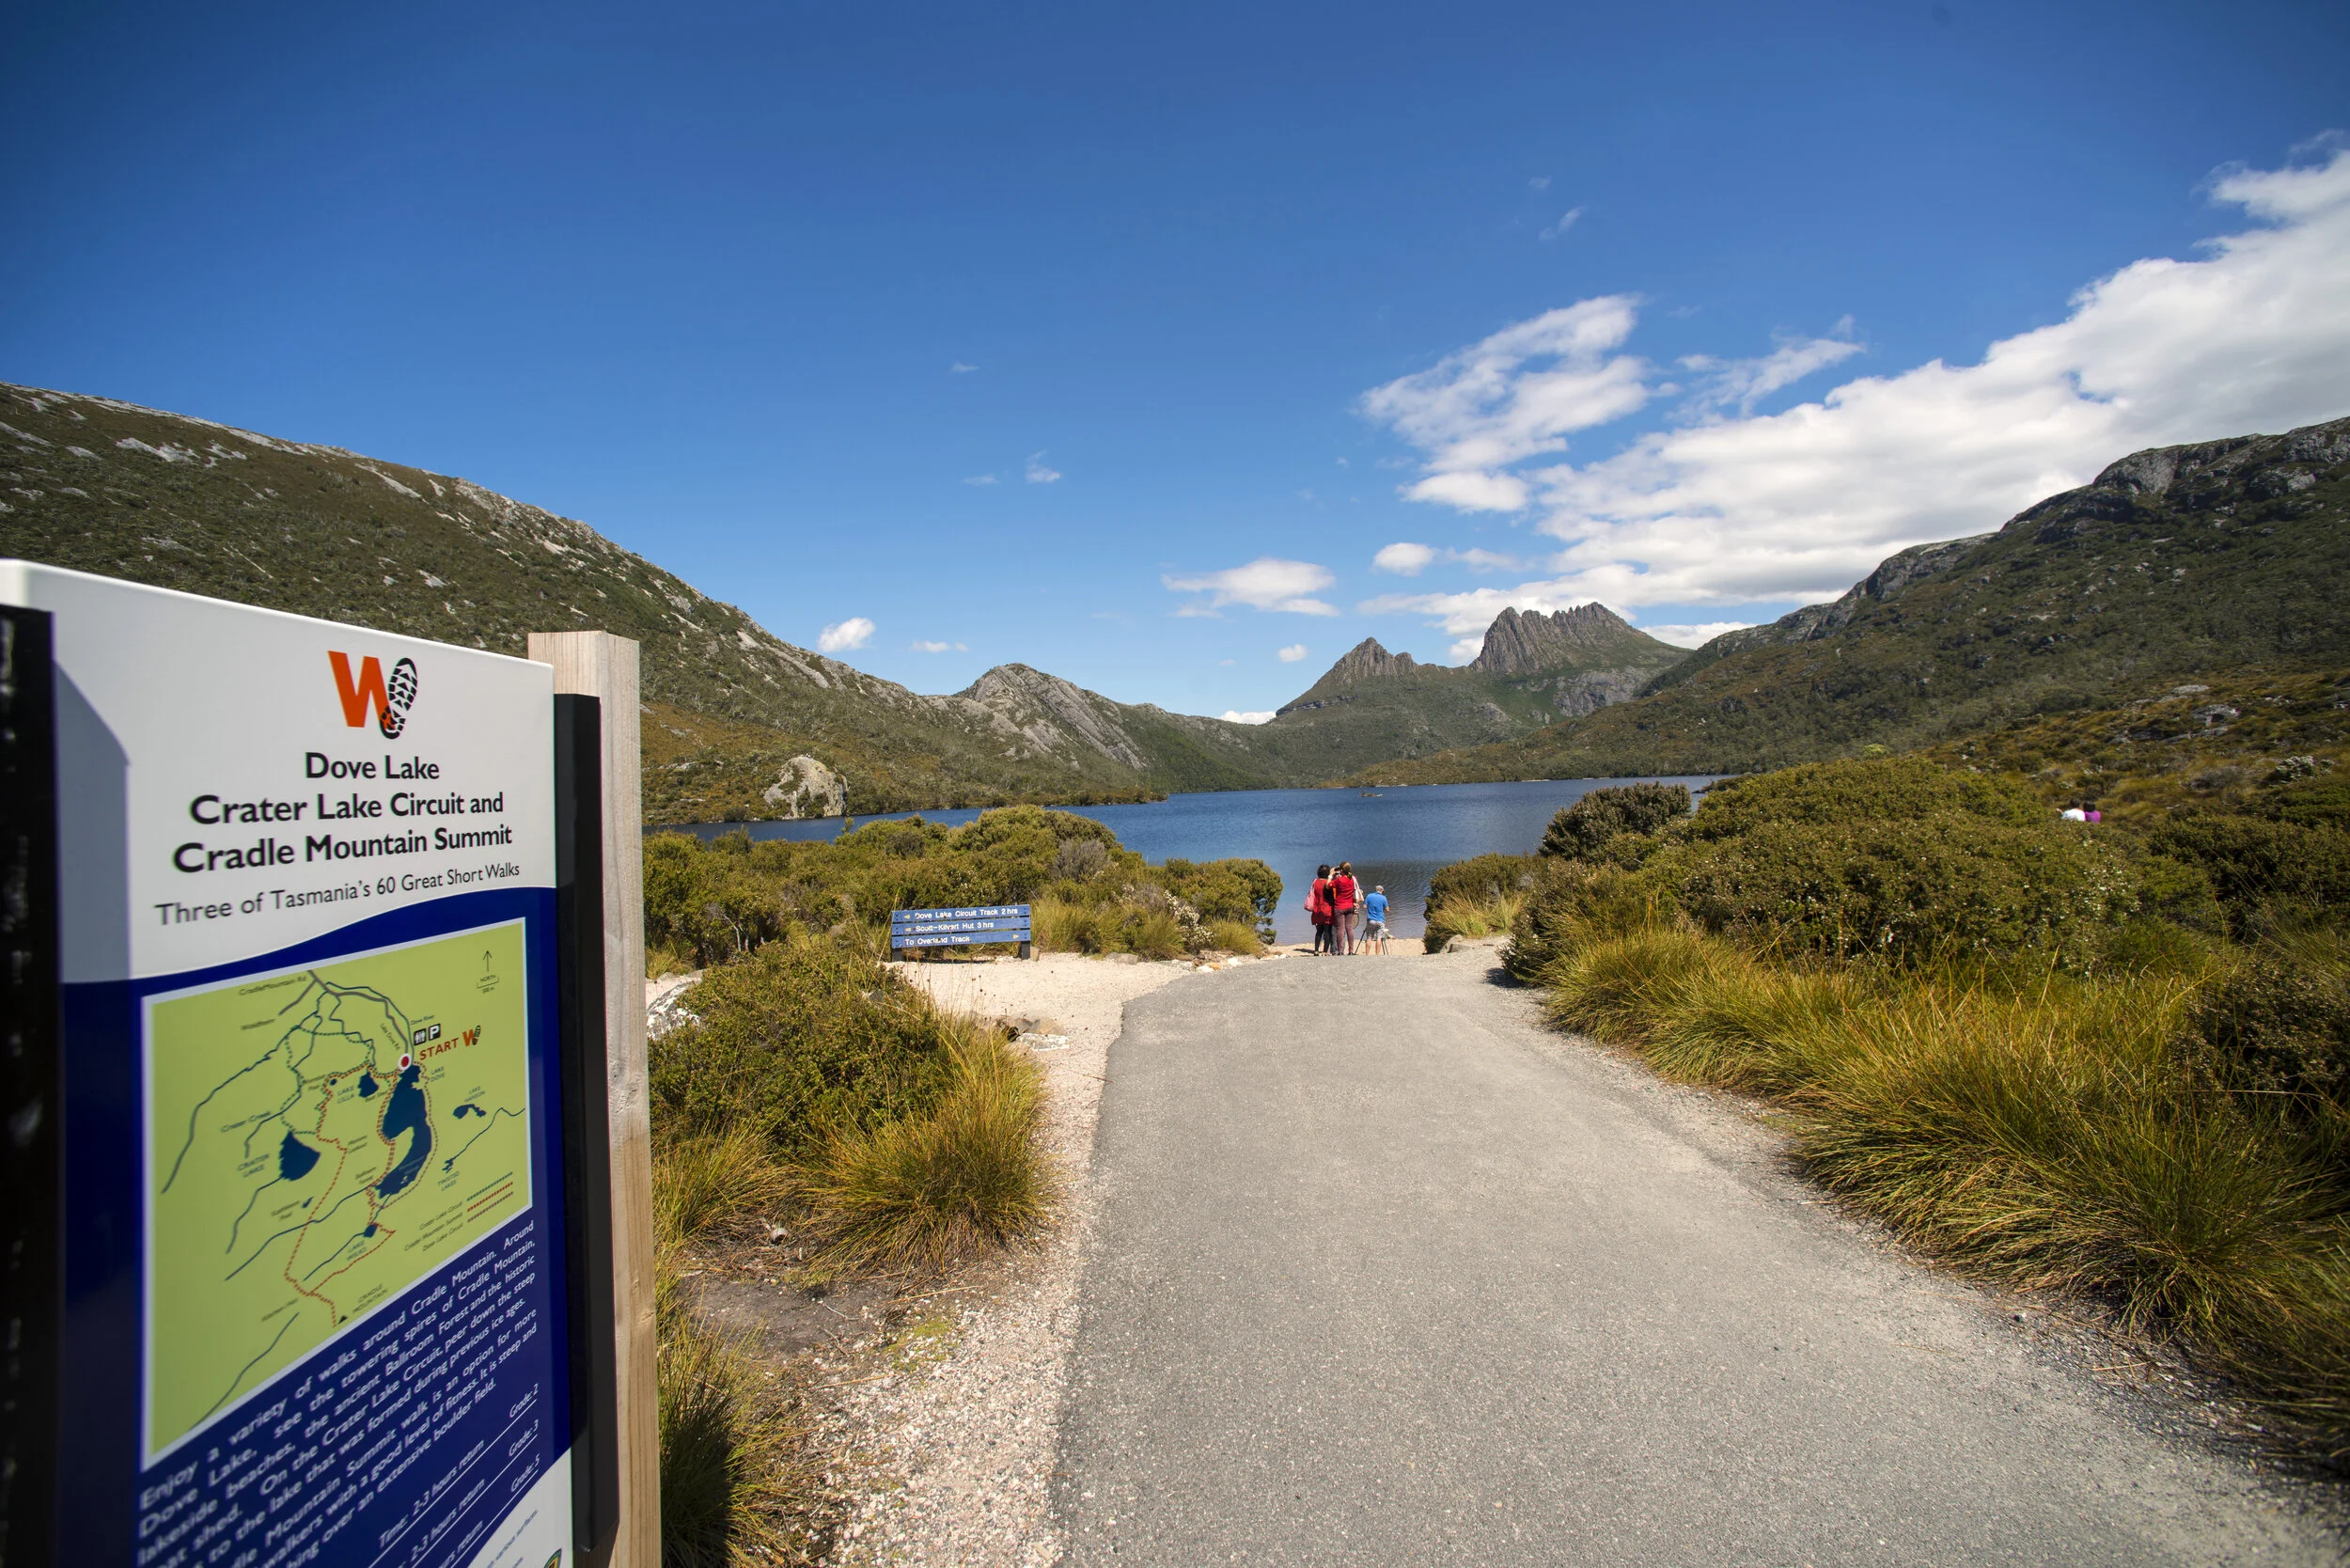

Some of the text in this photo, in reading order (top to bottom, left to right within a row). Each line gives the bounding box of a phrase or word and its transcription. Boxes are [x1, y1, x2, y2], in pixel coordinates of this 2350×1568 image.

[190, 792, 504, 824] Crater Lake Circuit and
[305, 752, 440, 779] Dove Lake
[154, 862, 520, 926] Three of Tasmania's 60 Great Short Walks
[173, 823, 512, 873] Cradle Mountain Summit
[419, 1037, 459, 1060] START
[137, 1499, 218, 1568] lakeside
[226, 1442, 296, 1498] beaches,
[305, 1415, 329, 1438] the
[334, 1374, 381, 1416] ancient
[384, 1333, 434, 1377] Ballroom
[438, 1306, 469, 1335] Forest
[470, 1290, 487, 1310] and
[488, 1281, 502, 1297] the
[505, 1256, 535, 1284] historic
[139, 1488, 198, 1540] Dove
[274, 1412, 302, 1438] see
[309, 1388, 335, 1412] the
[340, 1339, 400, 1388] towering
[404, 1311, 437, 1342] spires
[442, 1294, 454, 1312] of
[458, 1272, 490, 1300] Cradle
[494, 1240, 535, 1274] Mountain,
[140, 1220, 534, 1510] Enjoy a variety of walks around Cradle Mountain. Around
[259, 1469, 288, 1495] On
[292, 1445, 319, 1471] the
[321, 1404, 368, 1446] Crater
[371, 1380, 400, 1408] Lake
[445, 1325, 468, 1354] peer
[470, 1304, 495, 1329] down
[497, 1291, 512, 1307] the
[513, 1272, 535, 1294] steep
[265, 1309, 537, 1547] Mountain Summit walk is an option for more
[325, 1483, 357, 1516] with
[370, 1440, 402, 1482] good
[404, 1416, 431, 1449] level
[432, 1403, 445, 1422] of
[480, 1368, 488, 1381] It
[489, 1360, 497, 1372] is
[498, 1339, 521, 1364] steep
[522, 1322, 537, 1343] and
[209, 1539, 231, 1563] to
[236, 1511, 266, 1542] the
[269, 1482, 303, 1513] lake
[306, 1452, 337, 1484] that
[339, 1429, 366, 1456] was
[368, 1388, 412, 1434] formed
[414, 1360, 448, 1394] during
[449, 1326, 490, 1369] previous
[491, 1315, 505, 1330] ice
[321, 1507, 356, 1544] over
[357, 1491, 375, 1513] an
[377, 1438, 432, 1494] extensive
[433, 1400, 474, 1442] boulder
[413, 1490, 431, 1517] 2-3
[431, 1466, 458, 1498] hours
[459, 1439, 484, 1470] return
[509, 1390, 533, 1419] Grade:
[532, 1382, 539, 1397] 2
[430, 1507, 457, 1542] hours
[459, 1478, 485, 1511] return
[509, 1426, 533, 1457] Grade:
[532, 1419, 539, 1432] 3
[457, 1520, 484, 1553] return
[510, 1462, 535, 1492] Grade:
[534, 1452, 540, 1467] 5
